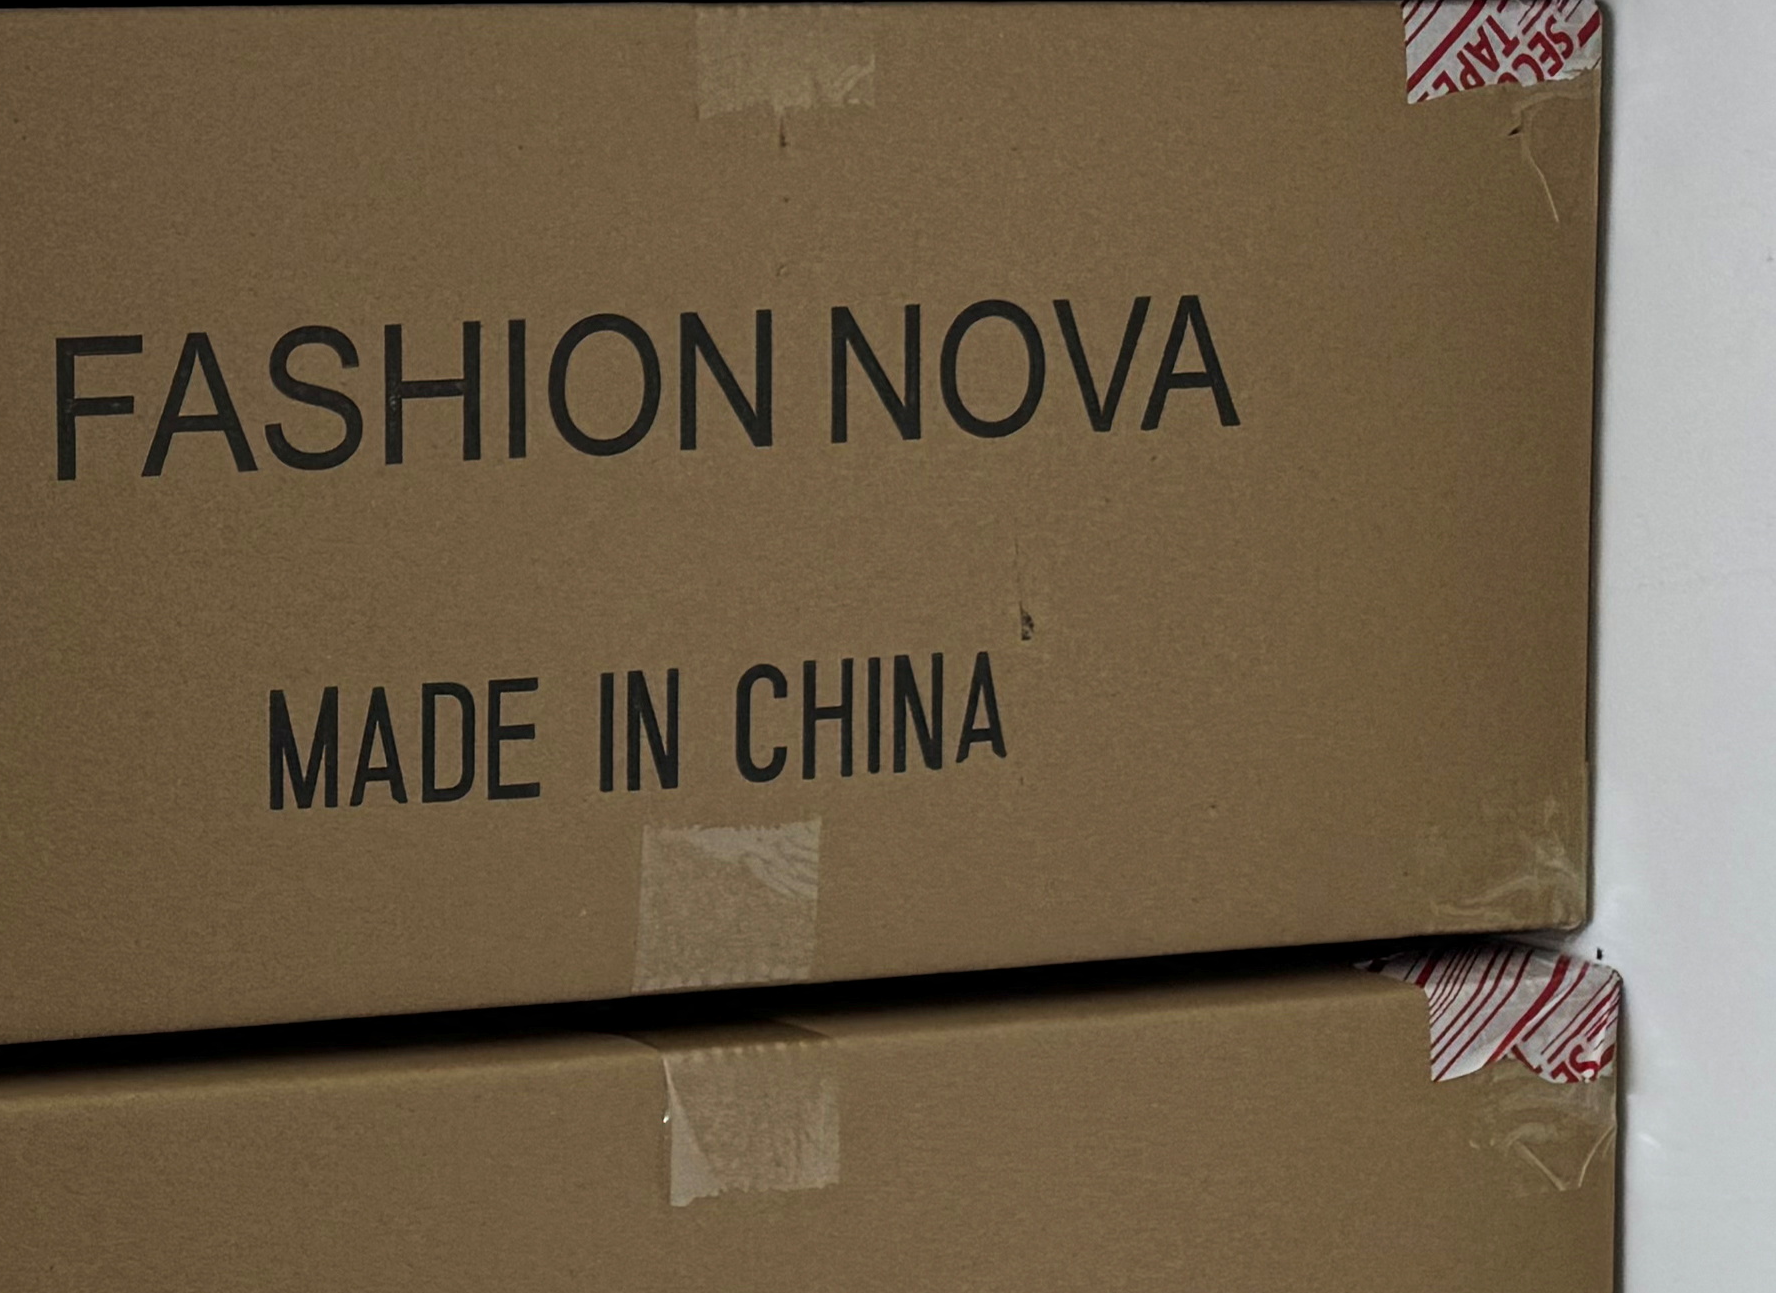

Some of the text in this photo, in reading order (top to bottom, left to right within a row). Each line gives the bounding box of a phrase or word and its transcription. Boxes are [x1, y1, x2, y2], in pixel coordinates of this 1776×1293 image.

[56, 295, 1240, 482] FASHION NOVA
[270, 651, 1007, 811] MADE IN CHINA
